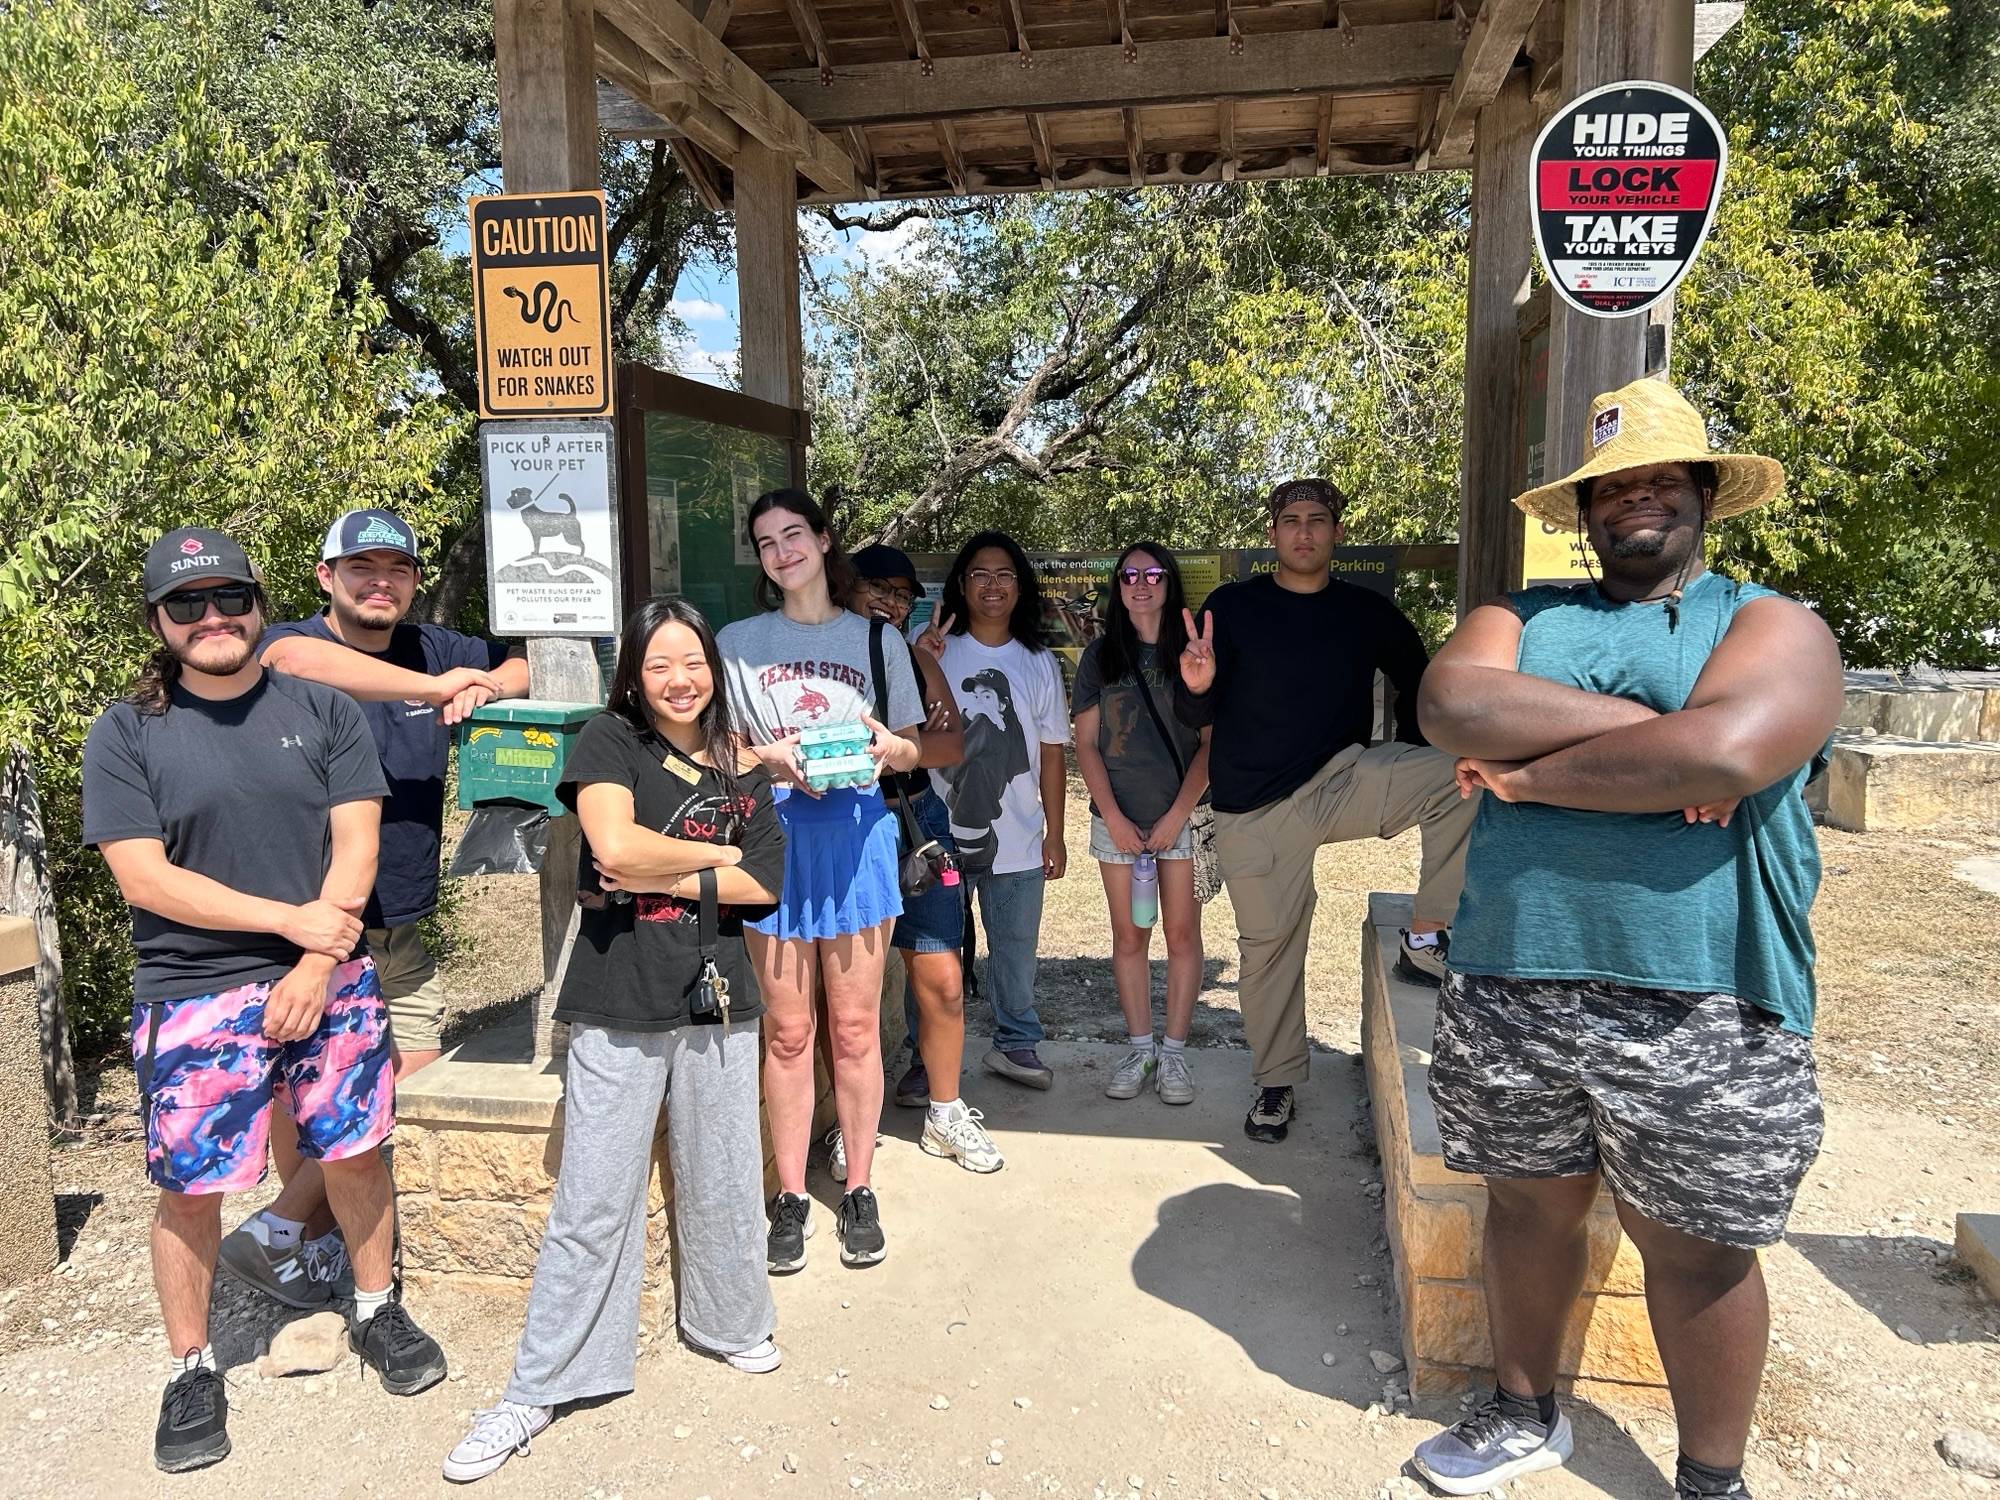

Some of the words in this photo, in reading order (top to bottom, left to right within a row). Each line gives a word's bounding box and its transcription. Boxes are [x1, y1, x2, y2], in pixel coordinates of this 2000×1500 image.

[1572, 112, 1690, 144] HIDE
[1573, 146, 1618, 157] YOUR
[1622, 145, 1685, 157] THINGS
[1568, 167, 1683, 192] LOCK
[1569, 195, 1610, 205] YOUR
[1615, 195, 1680, 205] VEHICLE
[482, 215, 597, 257] CAUTION
[1564, 215, 1679, 243] TAKE
[1564, 242, 1616, 255] YOUR
[1624, 242, 1676, 255] KEYS
[1613, 277, 1634, 287] ICT
[497, 347, 553, 368] WATCH
[559, 346, 592, 367] OUT
[497, 377, 529, 397] FOR
[535, 375, 595, 396] SNAKES
[490, 441, 526, 454] PICK
[532, 441, 551, 453] UP
[556, 440, 604, 454] AFTER
[510, 459, 553, 471] YOUR
[559, 458, 585, 471] PET
[170, 555, 220, 574] SUNDT
[1051, 560, 1067, 569] the
[1069, 559, 1118, 571] endanger
[1250, 560, 1280, 573] Add
[1330, 559, 1385, 574] Parking
[1570, 559, 1602, 569] PRES
[1035, 573, 1109, 584] lden-cheeked
[1038, 588, 1068, 598] rbler
[759, 660, 815, 694] TEXAS
[819, 661, 866, 696] STATE
[497, 749, 553, 767] Mitten
[272, 1257, 304, 1283] N
